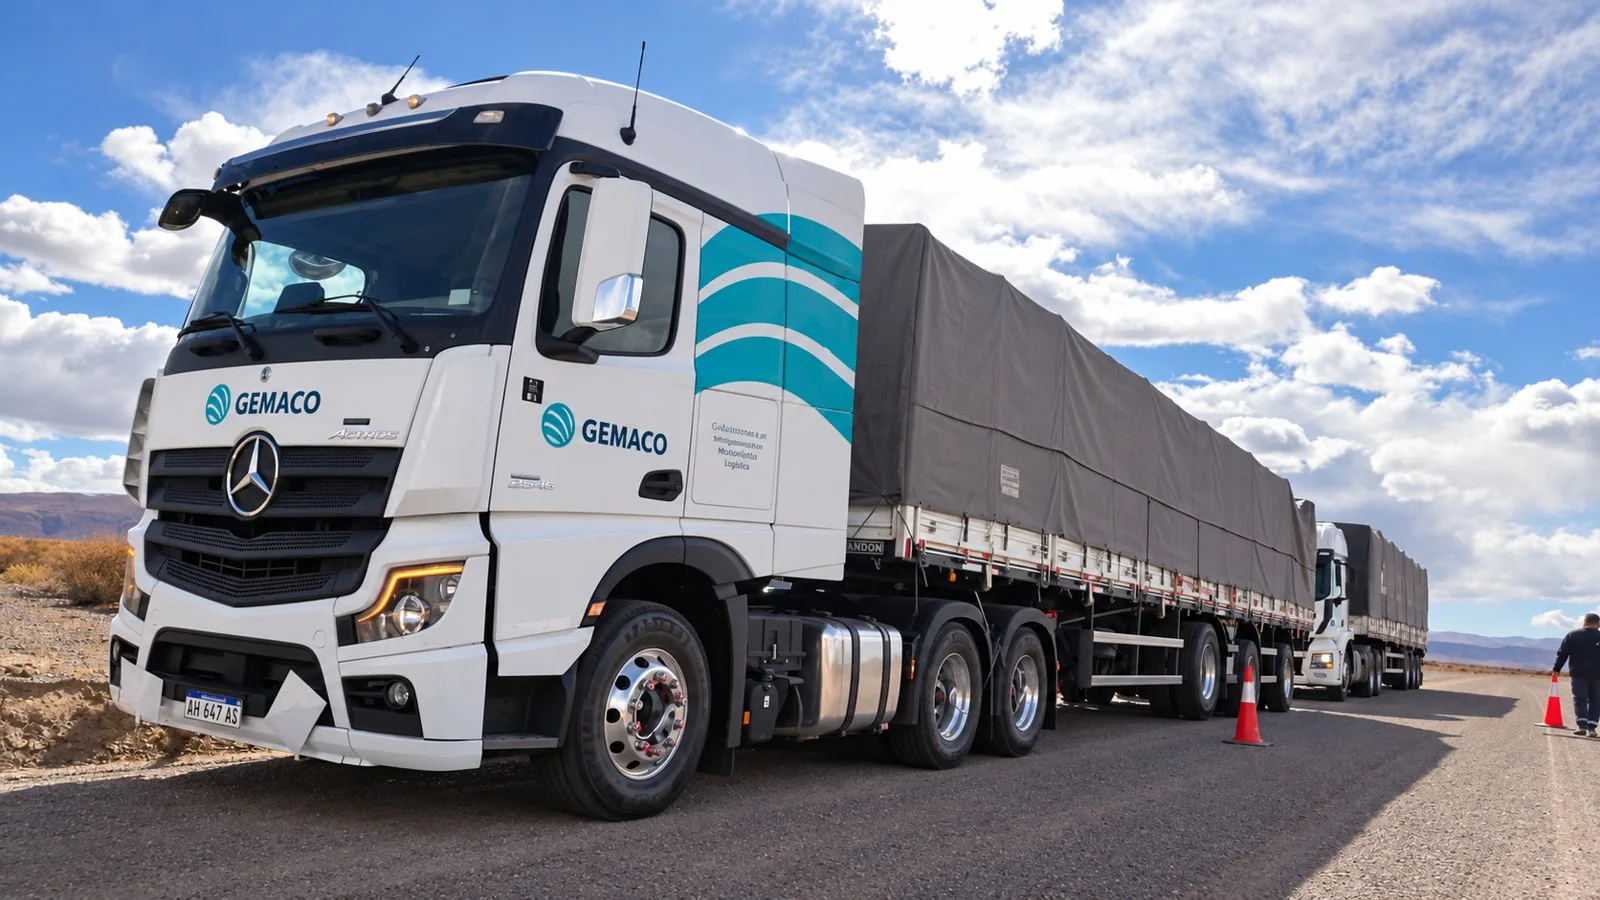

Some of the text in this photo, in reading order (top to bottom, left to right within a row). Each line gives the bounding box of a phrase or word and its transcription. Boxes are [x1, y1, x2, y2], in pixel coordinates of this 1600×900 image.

[235, 391, 321, 415] GEMACO
[582, 419, 668, 455] GEMACO
[847, 542, 882, 552] ANDON
[187, 699, 238, 724] AH 647 AS
